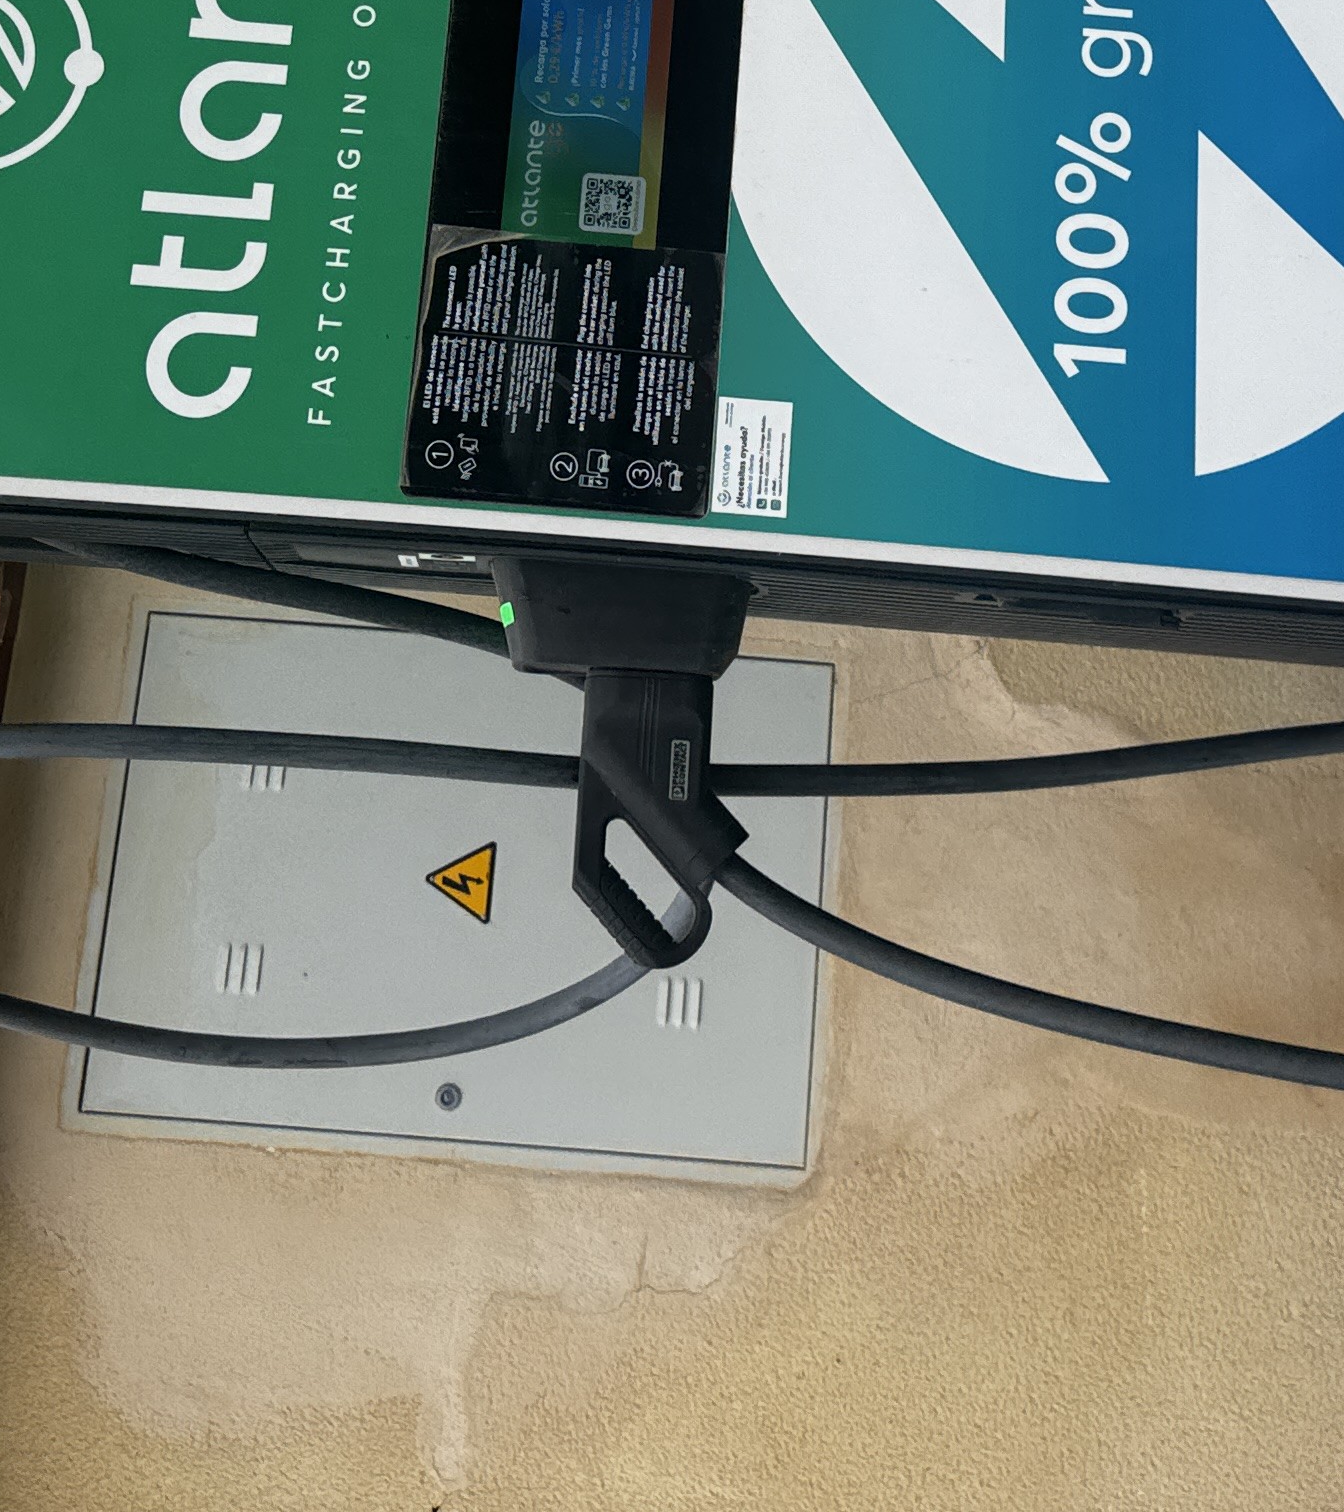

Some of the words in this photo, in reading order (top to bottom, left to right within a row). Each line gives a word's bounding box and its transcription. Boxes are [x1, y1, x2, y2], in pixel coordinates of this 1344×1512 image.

[534, 40, 549, 83] Recarga
[541, 20, 550, 38] por
[520, 120, 546, 227] atlante
[306, 57, 372, 425] FASTCHARGING
[1053, 112, 1133, 379] 100%
[423, 383, 432, 400] LED
